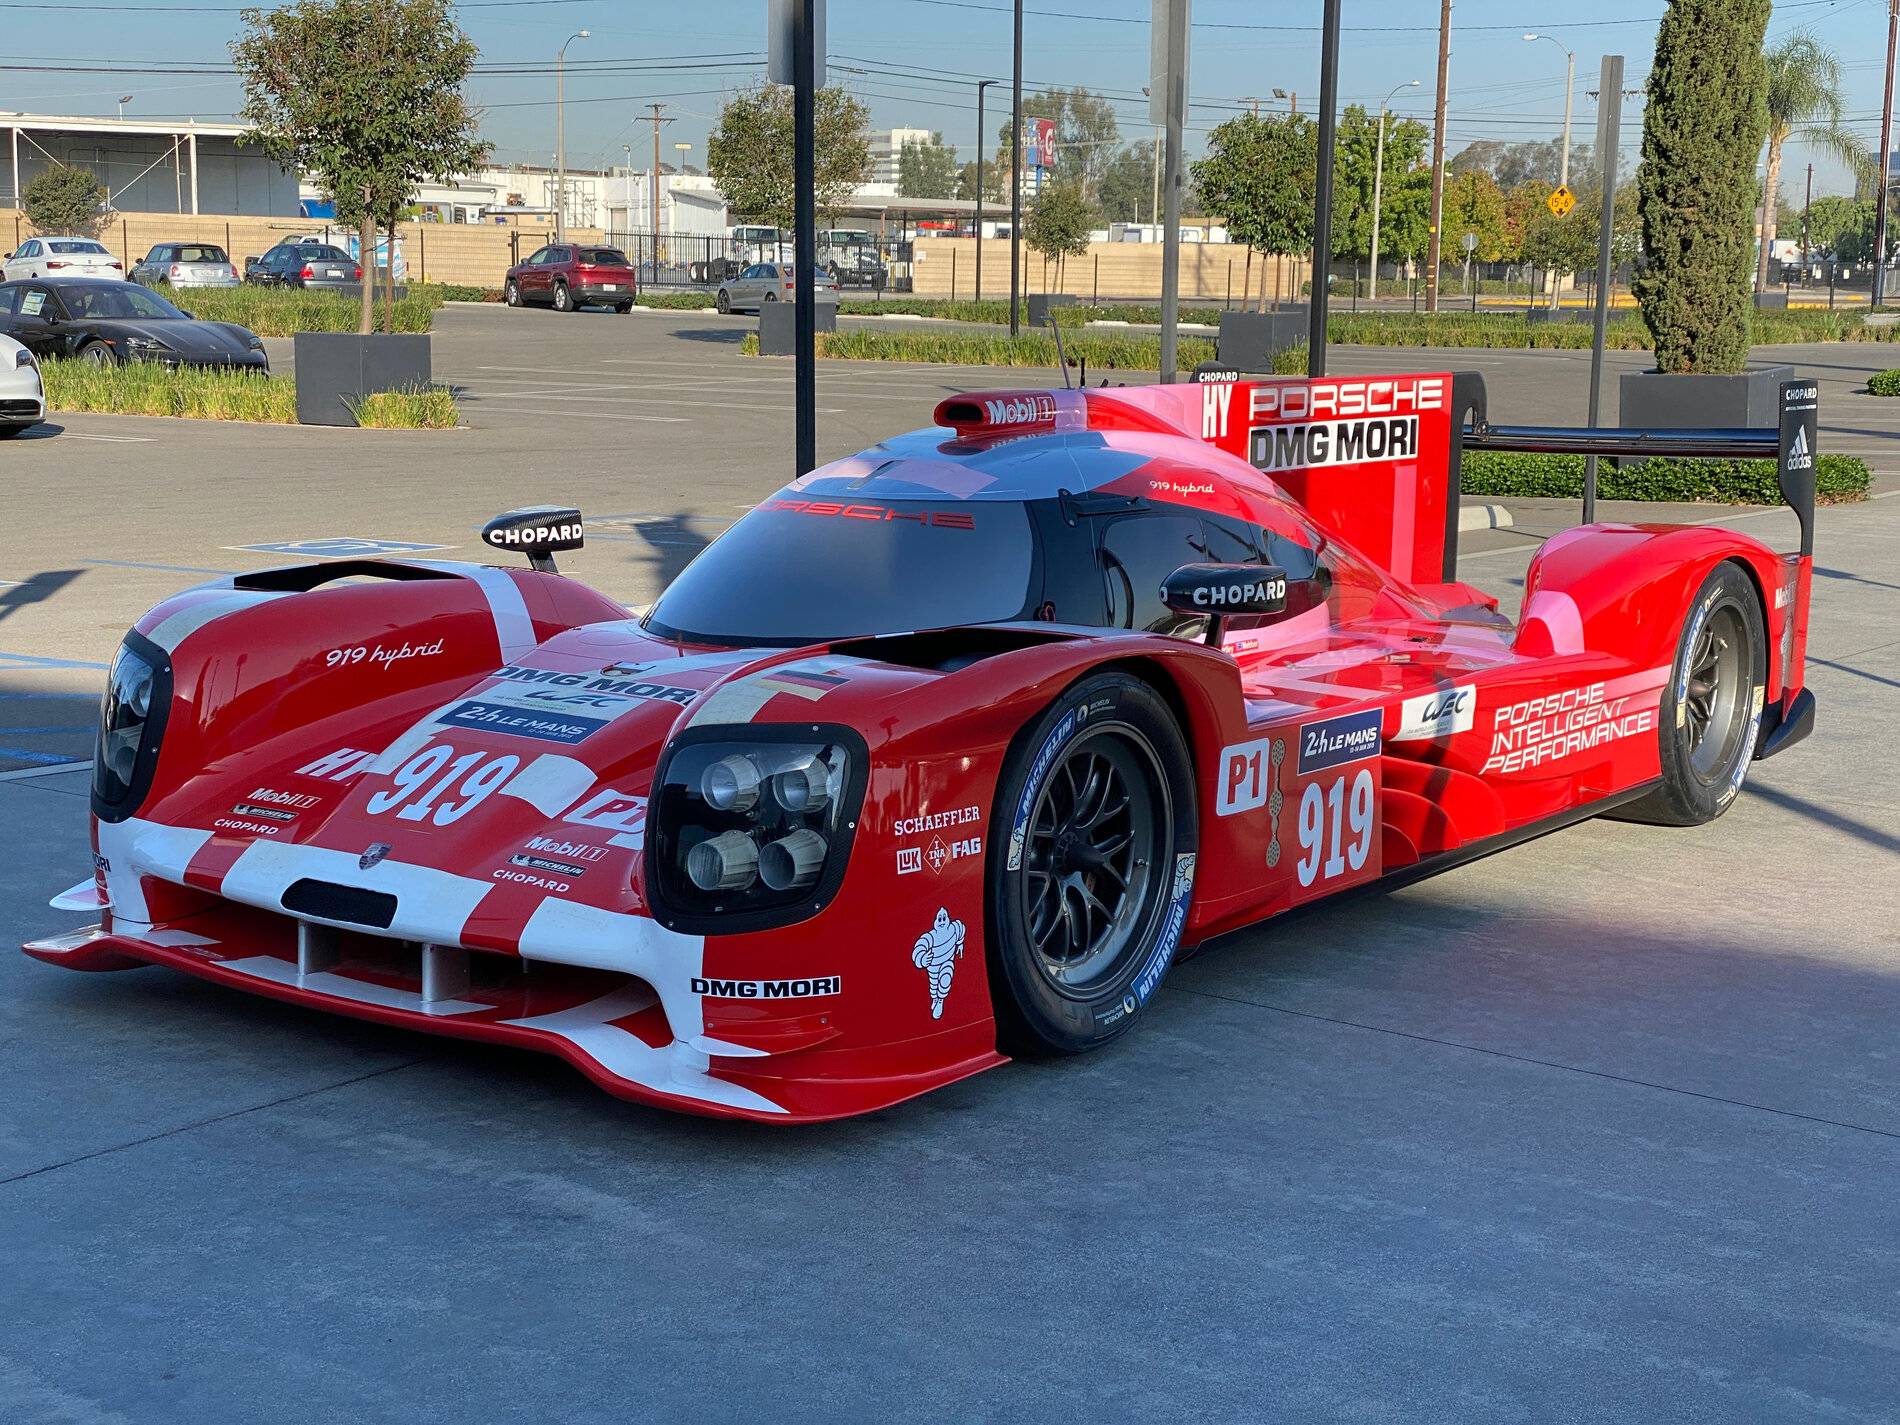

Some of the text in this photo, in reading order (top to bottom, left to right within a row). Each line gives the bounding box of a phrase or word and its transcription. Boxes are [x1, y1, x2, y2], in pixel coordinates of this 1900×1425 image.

[1199, 372, 1238, 382] CHOPARD
[1249, 380, 1443, 421] PORSCHE
[1785, 387, 1817, 400] CHOPARD
[985, 399, 1036, 425] Mobil
[1202, 384, 1233, 439] HY
[1251, 418, 1417, 470] DMG MORI
[1787, 454, 1812, 470] adidas
[1150, 480, 1214, 499] 919 hybrid
[489, 524, 583, 544] CHOPARD
[1193, 579, 1286, 605] CHOPARD
[326, 638, 443, 671] 919 hybrid
[492, 666, 582, 687] DMG
[1494, 682, 1605, 740] PORSCHE
[497, 715, 529, 727] LE
[522, 721, 588, 736] MANS
[1490, 697, 1631, 755] INTELLIGENT
[1328, 734, 1345, 752] LE
[1344, 726, 1378, 748] MANS
[1478, 711, 1652, 775] PERFORMANCE
[1022, 717, 1073, 816] MICHELIN
[1226, 751, 1262, 805] P1
[247, 787, 304, 805] Mobil
[366, 744, 520, 827] 919
[248, 808, 295, 820] MICHELIN
[581, 798, 647, 827] P1
[894, 805, 980, 836] SCHAEFFLER
[214, 818, 279, 835] CHOPARD
[1297, 768, 1375, 888] 919
[524, 836, 588, 858] Mobil
[952, 837, 981, 859] FAG
[531, 859, 585, 875] MICHELIN
[492, 869, 570, 893] CHOPARD
[1139, 899, 1184, 999] MICHELIN
[690, 976, 839, 998] DMG MORI
